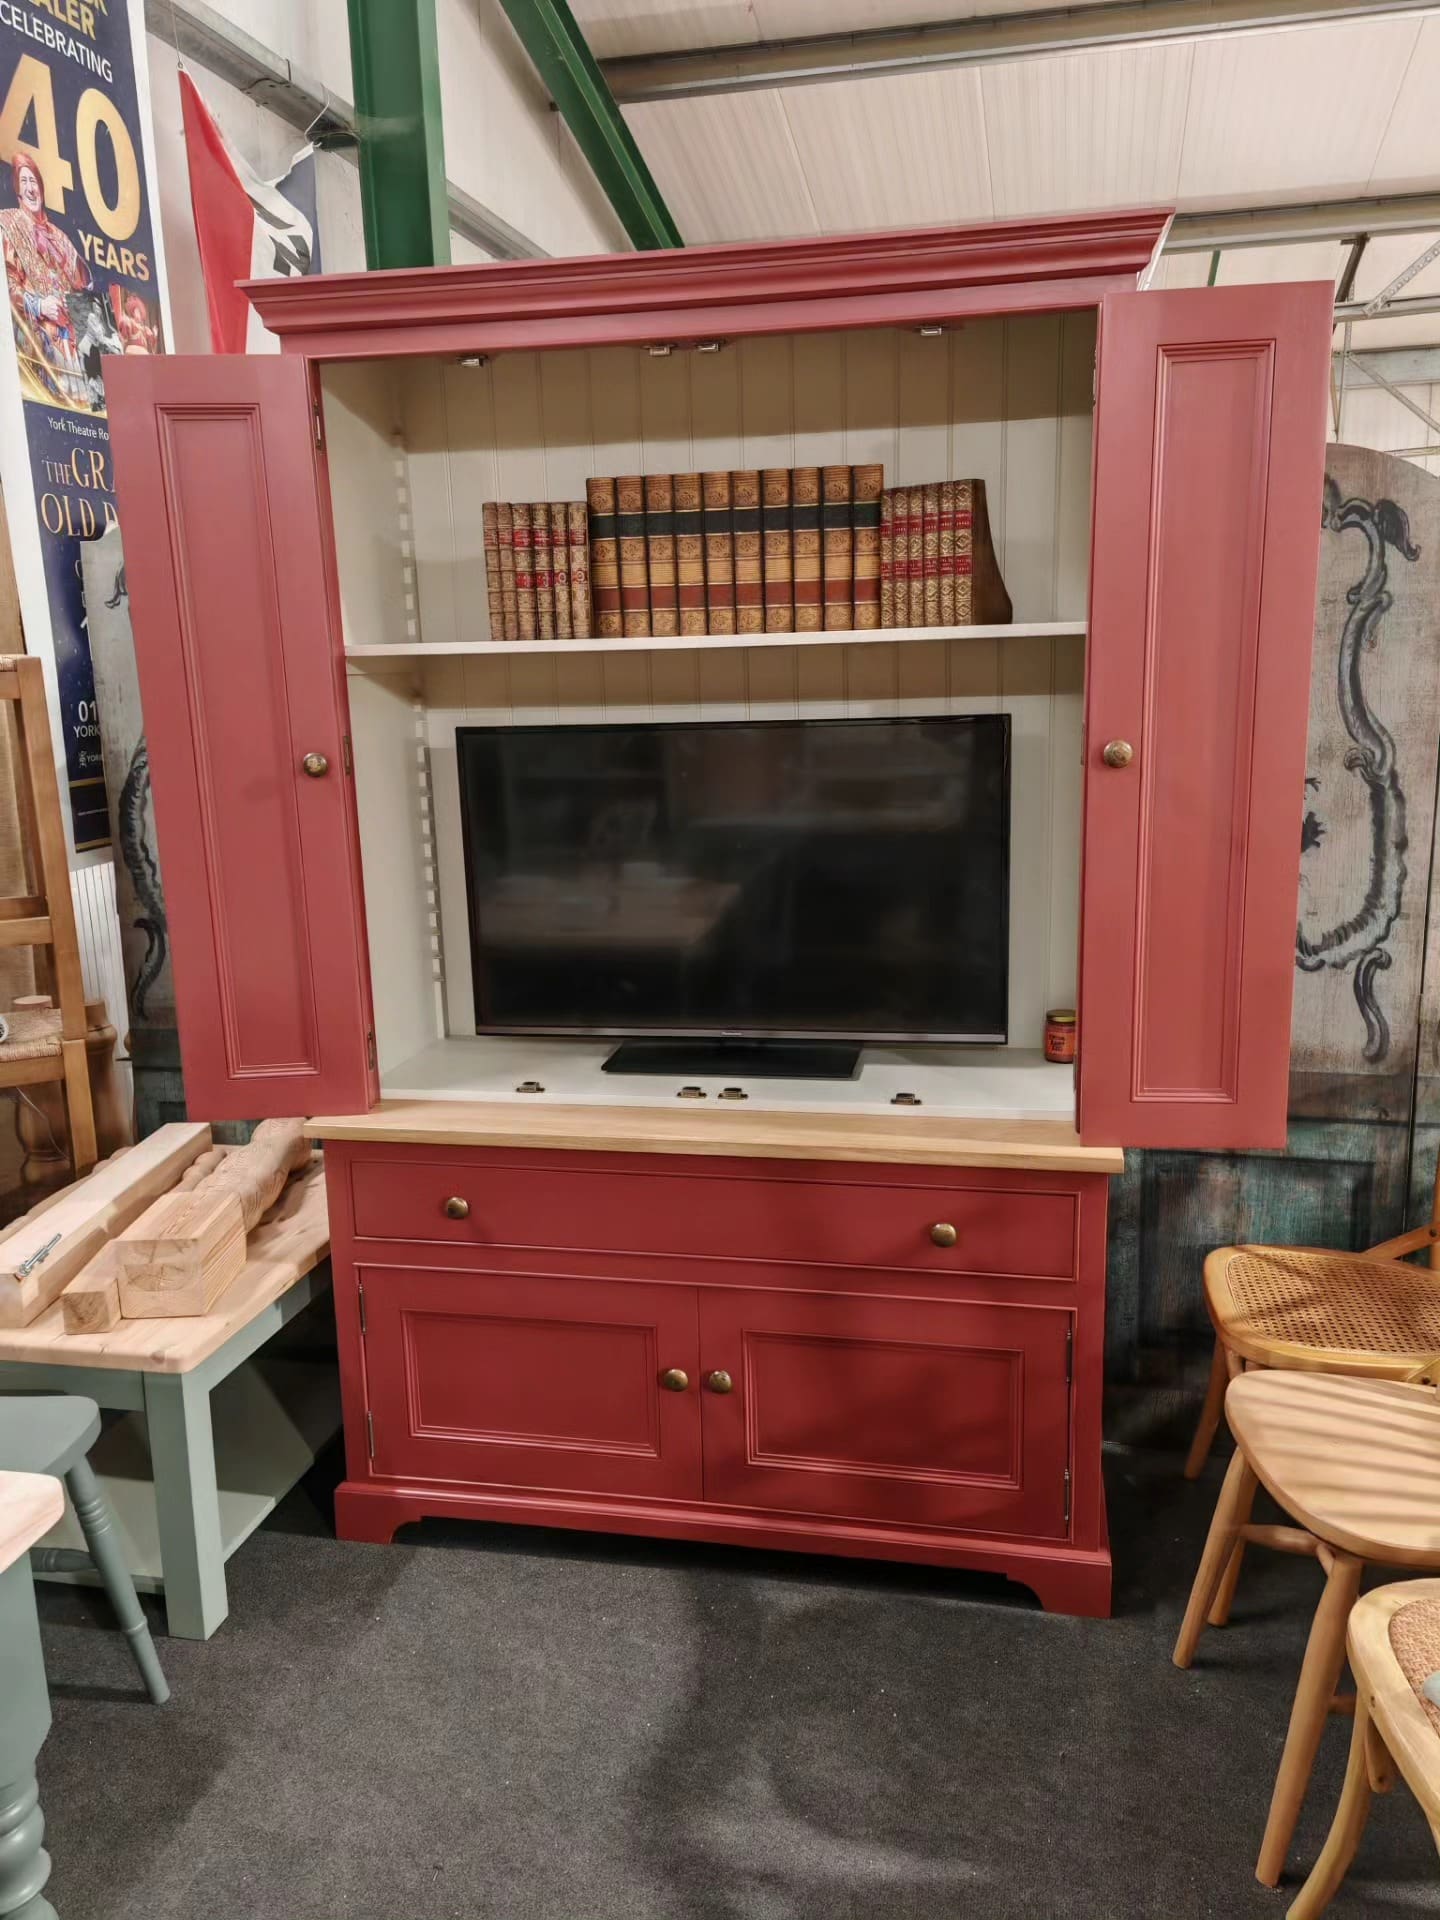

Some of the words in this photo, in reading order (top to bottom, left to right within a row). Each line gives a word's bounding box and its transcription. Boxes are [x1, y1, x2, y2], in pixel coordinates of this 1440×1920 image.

[0, 2, 113, 84] CELEBRATING
[0, 53, 140, 241] 40
[78, 229, 150, 281] YEARS
[47, 416, 66, 431] York
[66, 420, 98, 439] Theatre
[41, 457, 73, 486] THE
[71, 447, 115, 493] GR
[41, 493, 95, 537] OLD
